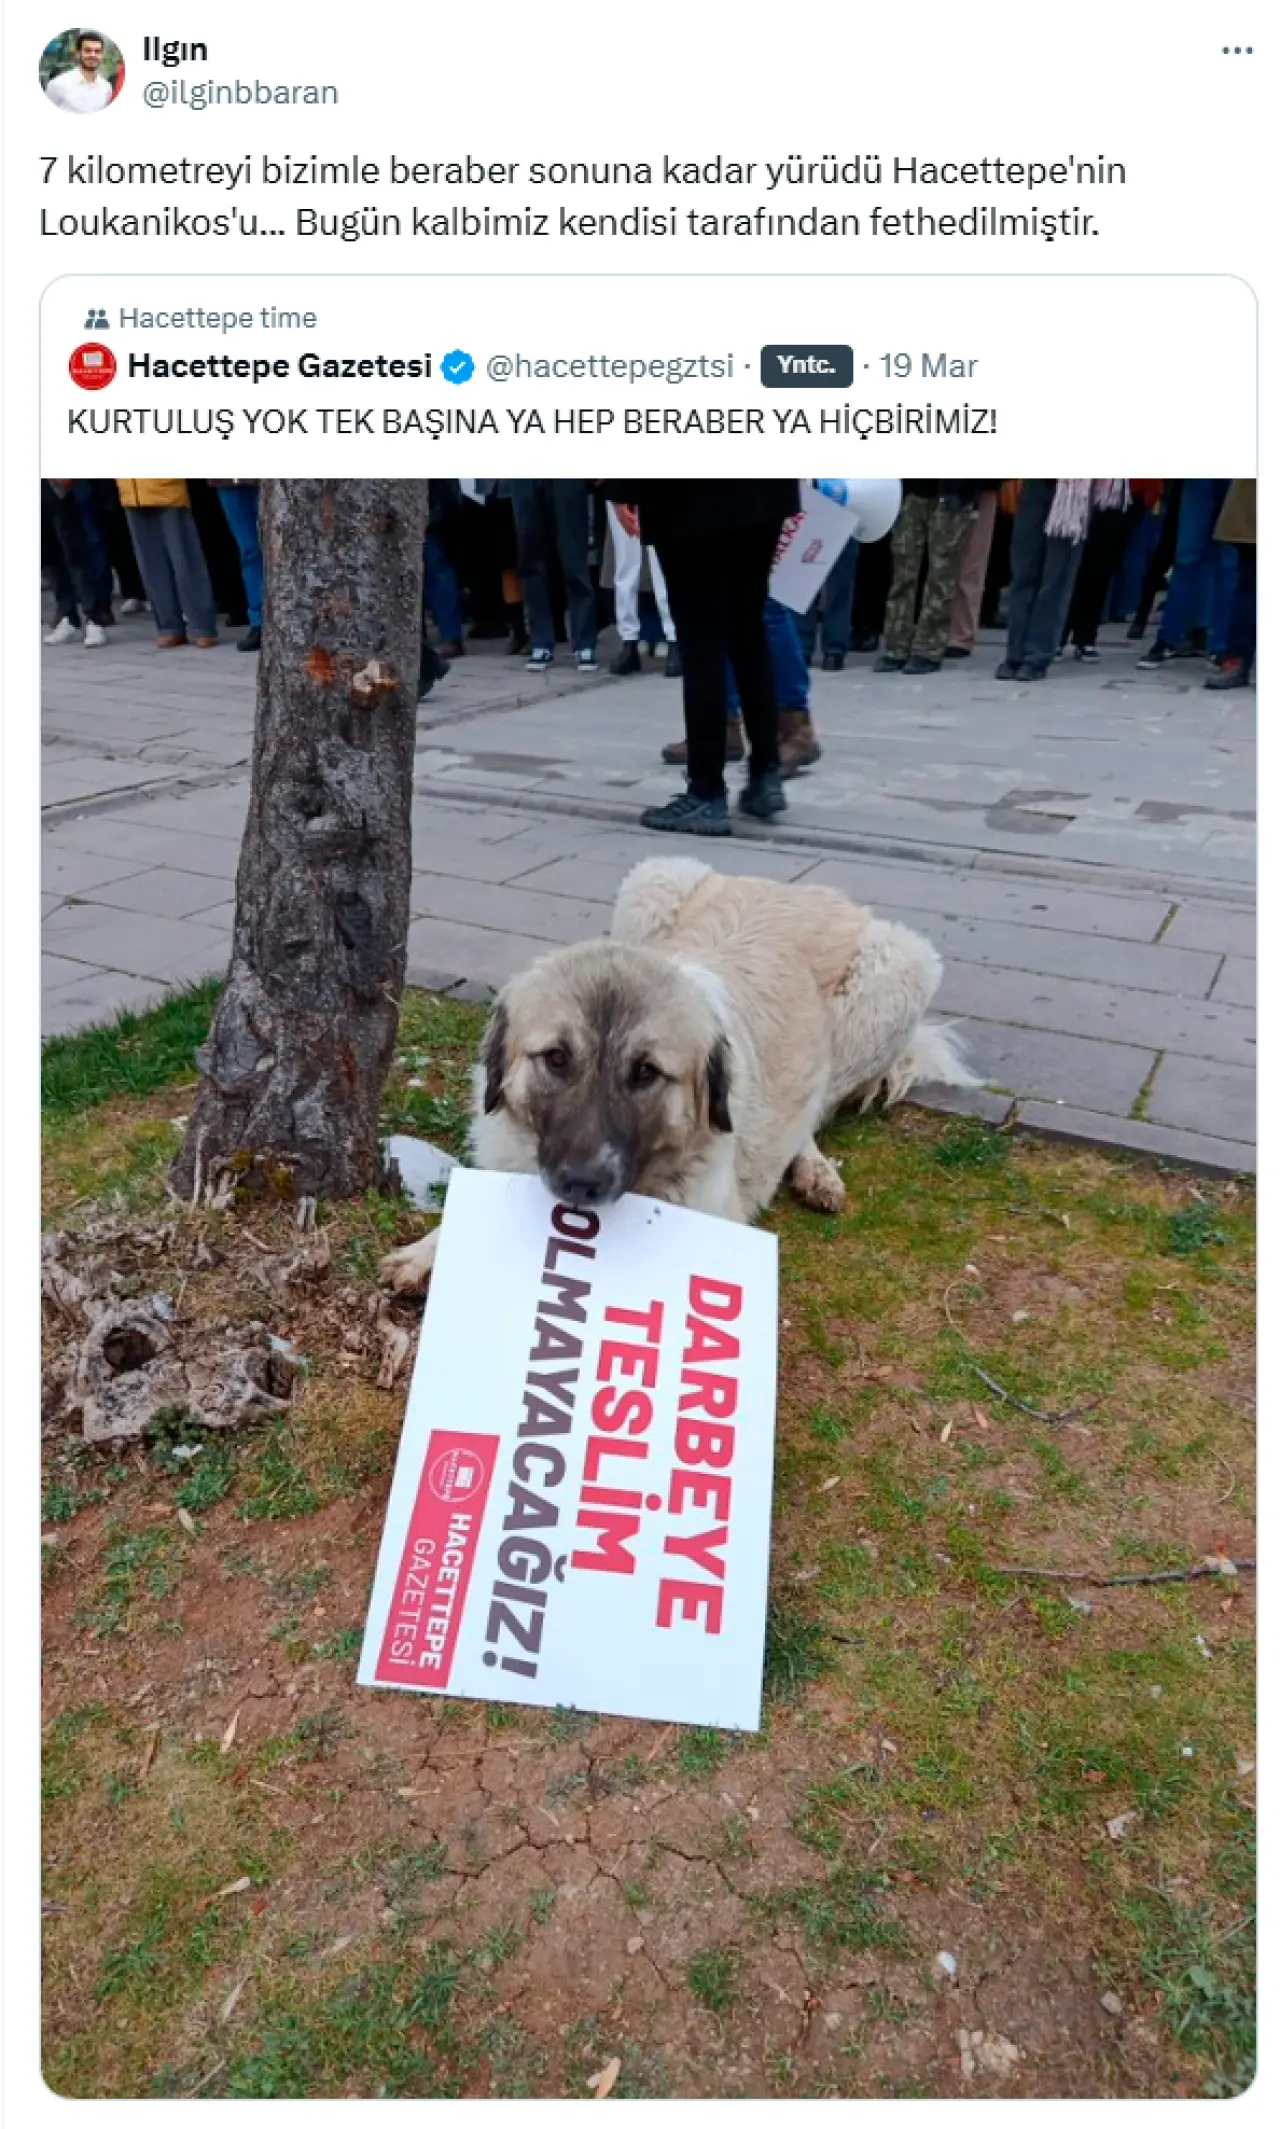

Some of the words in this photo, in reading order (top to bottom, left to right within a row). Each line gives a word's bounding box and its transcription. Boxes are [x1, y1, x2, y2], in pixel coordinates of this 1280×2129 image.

[482, 1202, 602, 1680] OLMAYACAĞIZ!
[571, 1300, 664, 1575] TESLİM
[656, 1274, 743, 1635] DARBEYE
[388, 1538, 436, 1667] GAZETESİ
[419, 1512, 473, 1670] HACETTEPE
